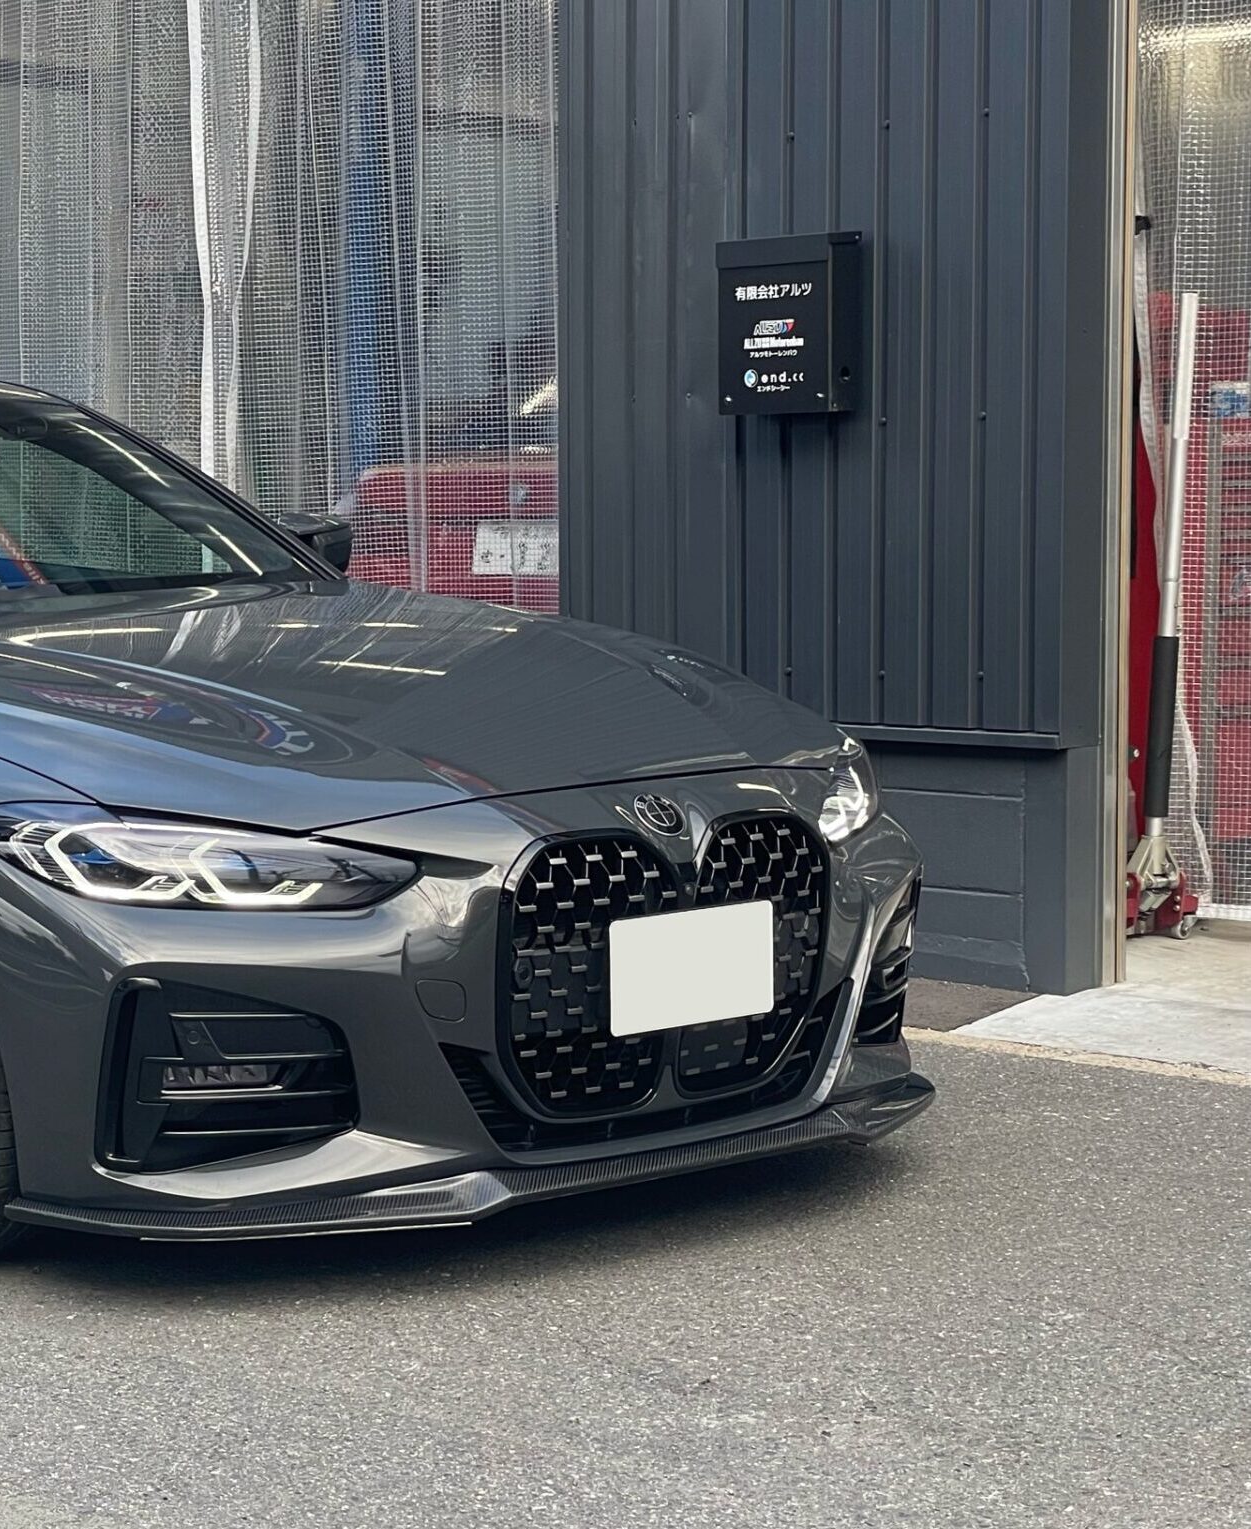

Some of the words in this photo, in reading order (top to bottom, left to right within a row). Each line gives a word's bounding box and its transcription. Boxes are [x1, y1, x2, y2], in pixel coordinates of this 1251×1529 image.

[735, 282, 812, 301] 有限会社アルツ
